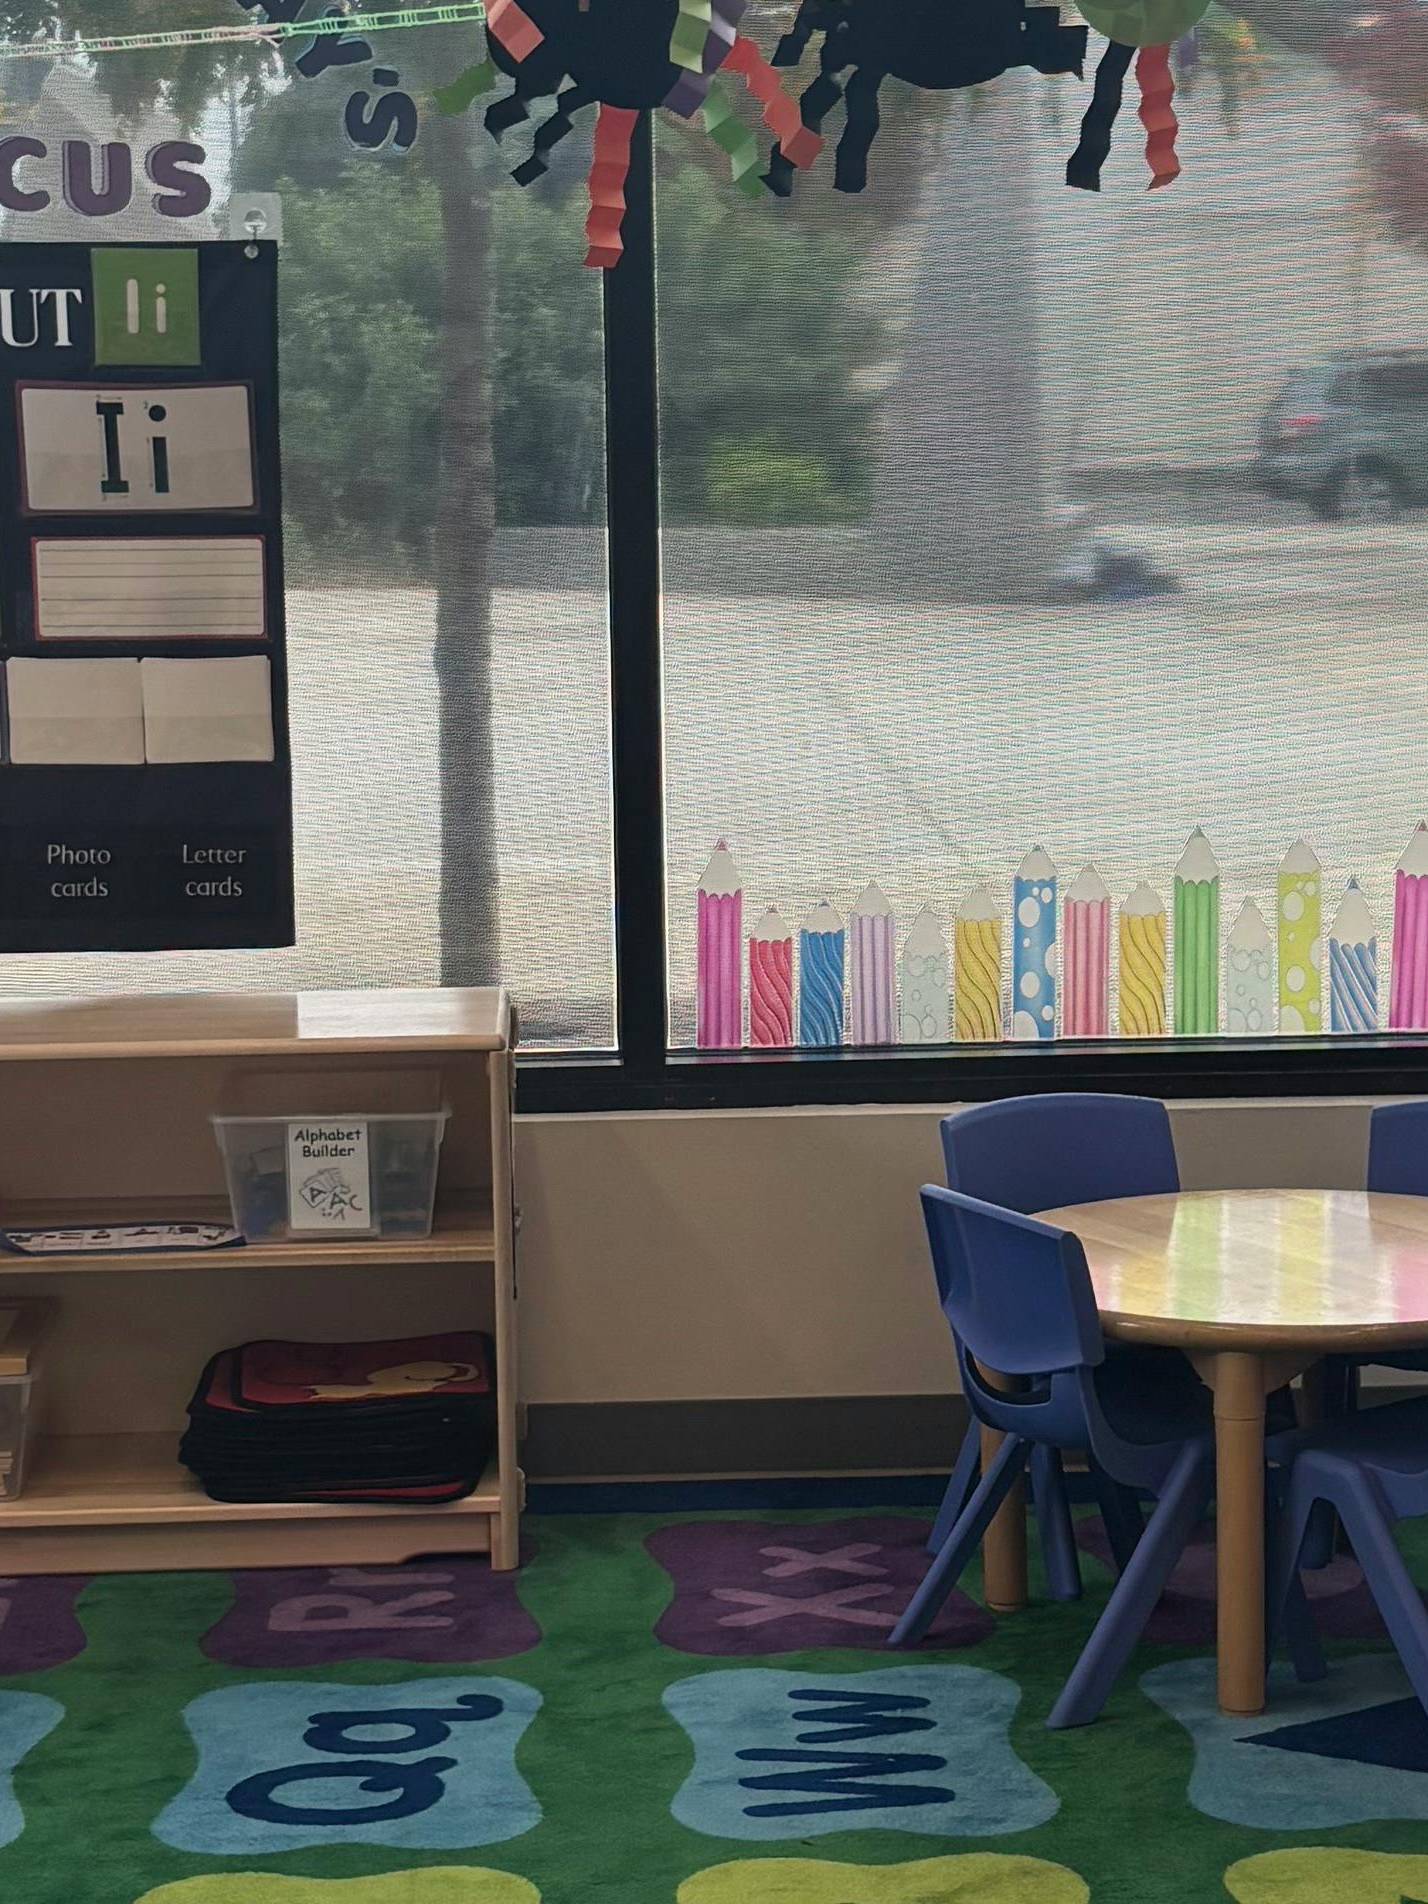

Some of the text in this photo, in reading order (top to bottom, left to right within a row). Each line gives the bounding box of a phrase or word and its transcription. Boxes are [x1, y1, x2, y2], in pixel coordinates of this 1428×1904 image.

[96, 400, 170, 493] Ii
[46, 844, 111, 866] Photo
[182, 844, 247, 866] Letter
[51, 876, 109, 899] cards
[185, 875, 243, 898] cards
[294, 1128, 362, 1145] Alphabet
[302, 1144, 355, 1158] Builder
[226, 1693, 503, 1828] Qq
[734, 1688, 955, 1818] Ww
